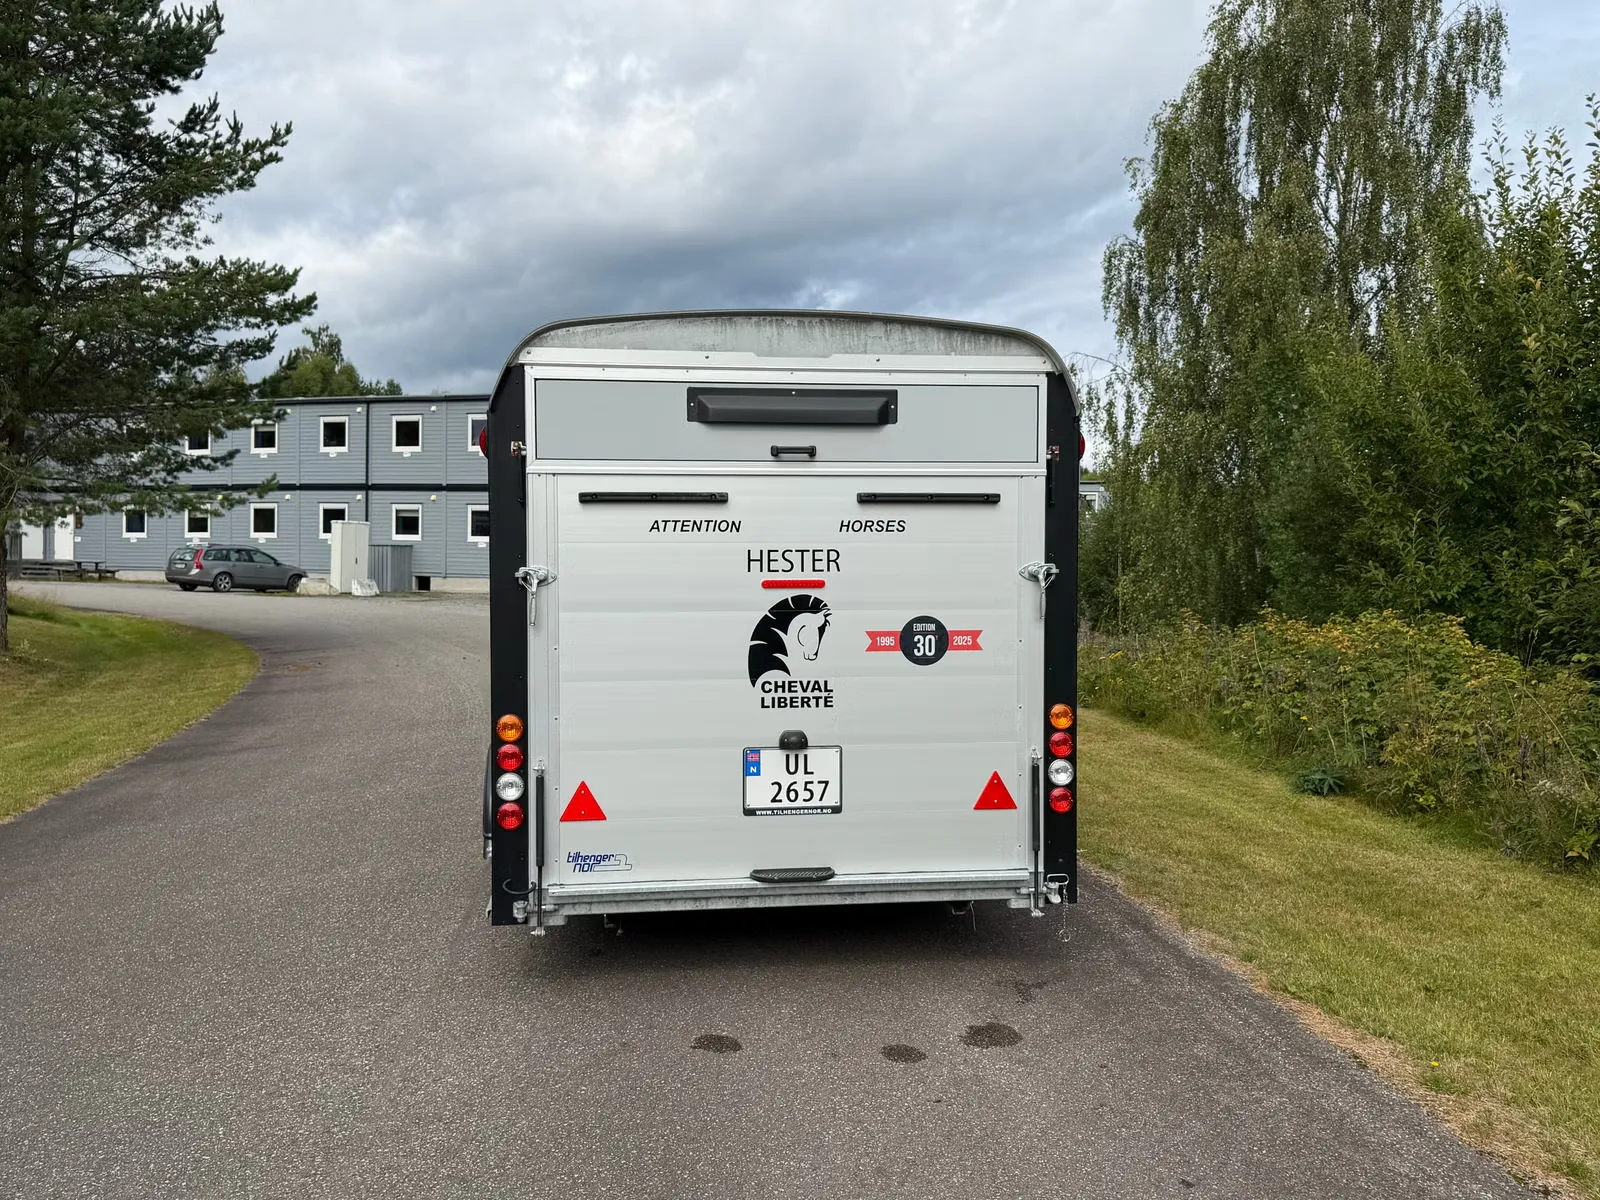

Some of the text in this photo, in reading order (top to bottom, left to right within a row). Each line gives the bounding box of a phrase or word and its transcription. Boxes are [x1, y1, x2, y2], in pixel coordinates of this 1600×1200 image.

[649, 519, 907, 533] ATTENTION HORSES
[747, 549, 841, 573] HESTER
[913, 623, 936, 632] EDITION
[876, 636, 895, 646] 1995
[952, 635, 973, 646] 2025
[760, 680, 834, 694] CHEVAL
[760, 692, 834, 709] LIBERTÉ
[785, 753, 814, 775] UL
[770, 780, 830, 803] 2657
[566, 851, 615, 865] tilhenger
[572, 862, 599, 873] nor
